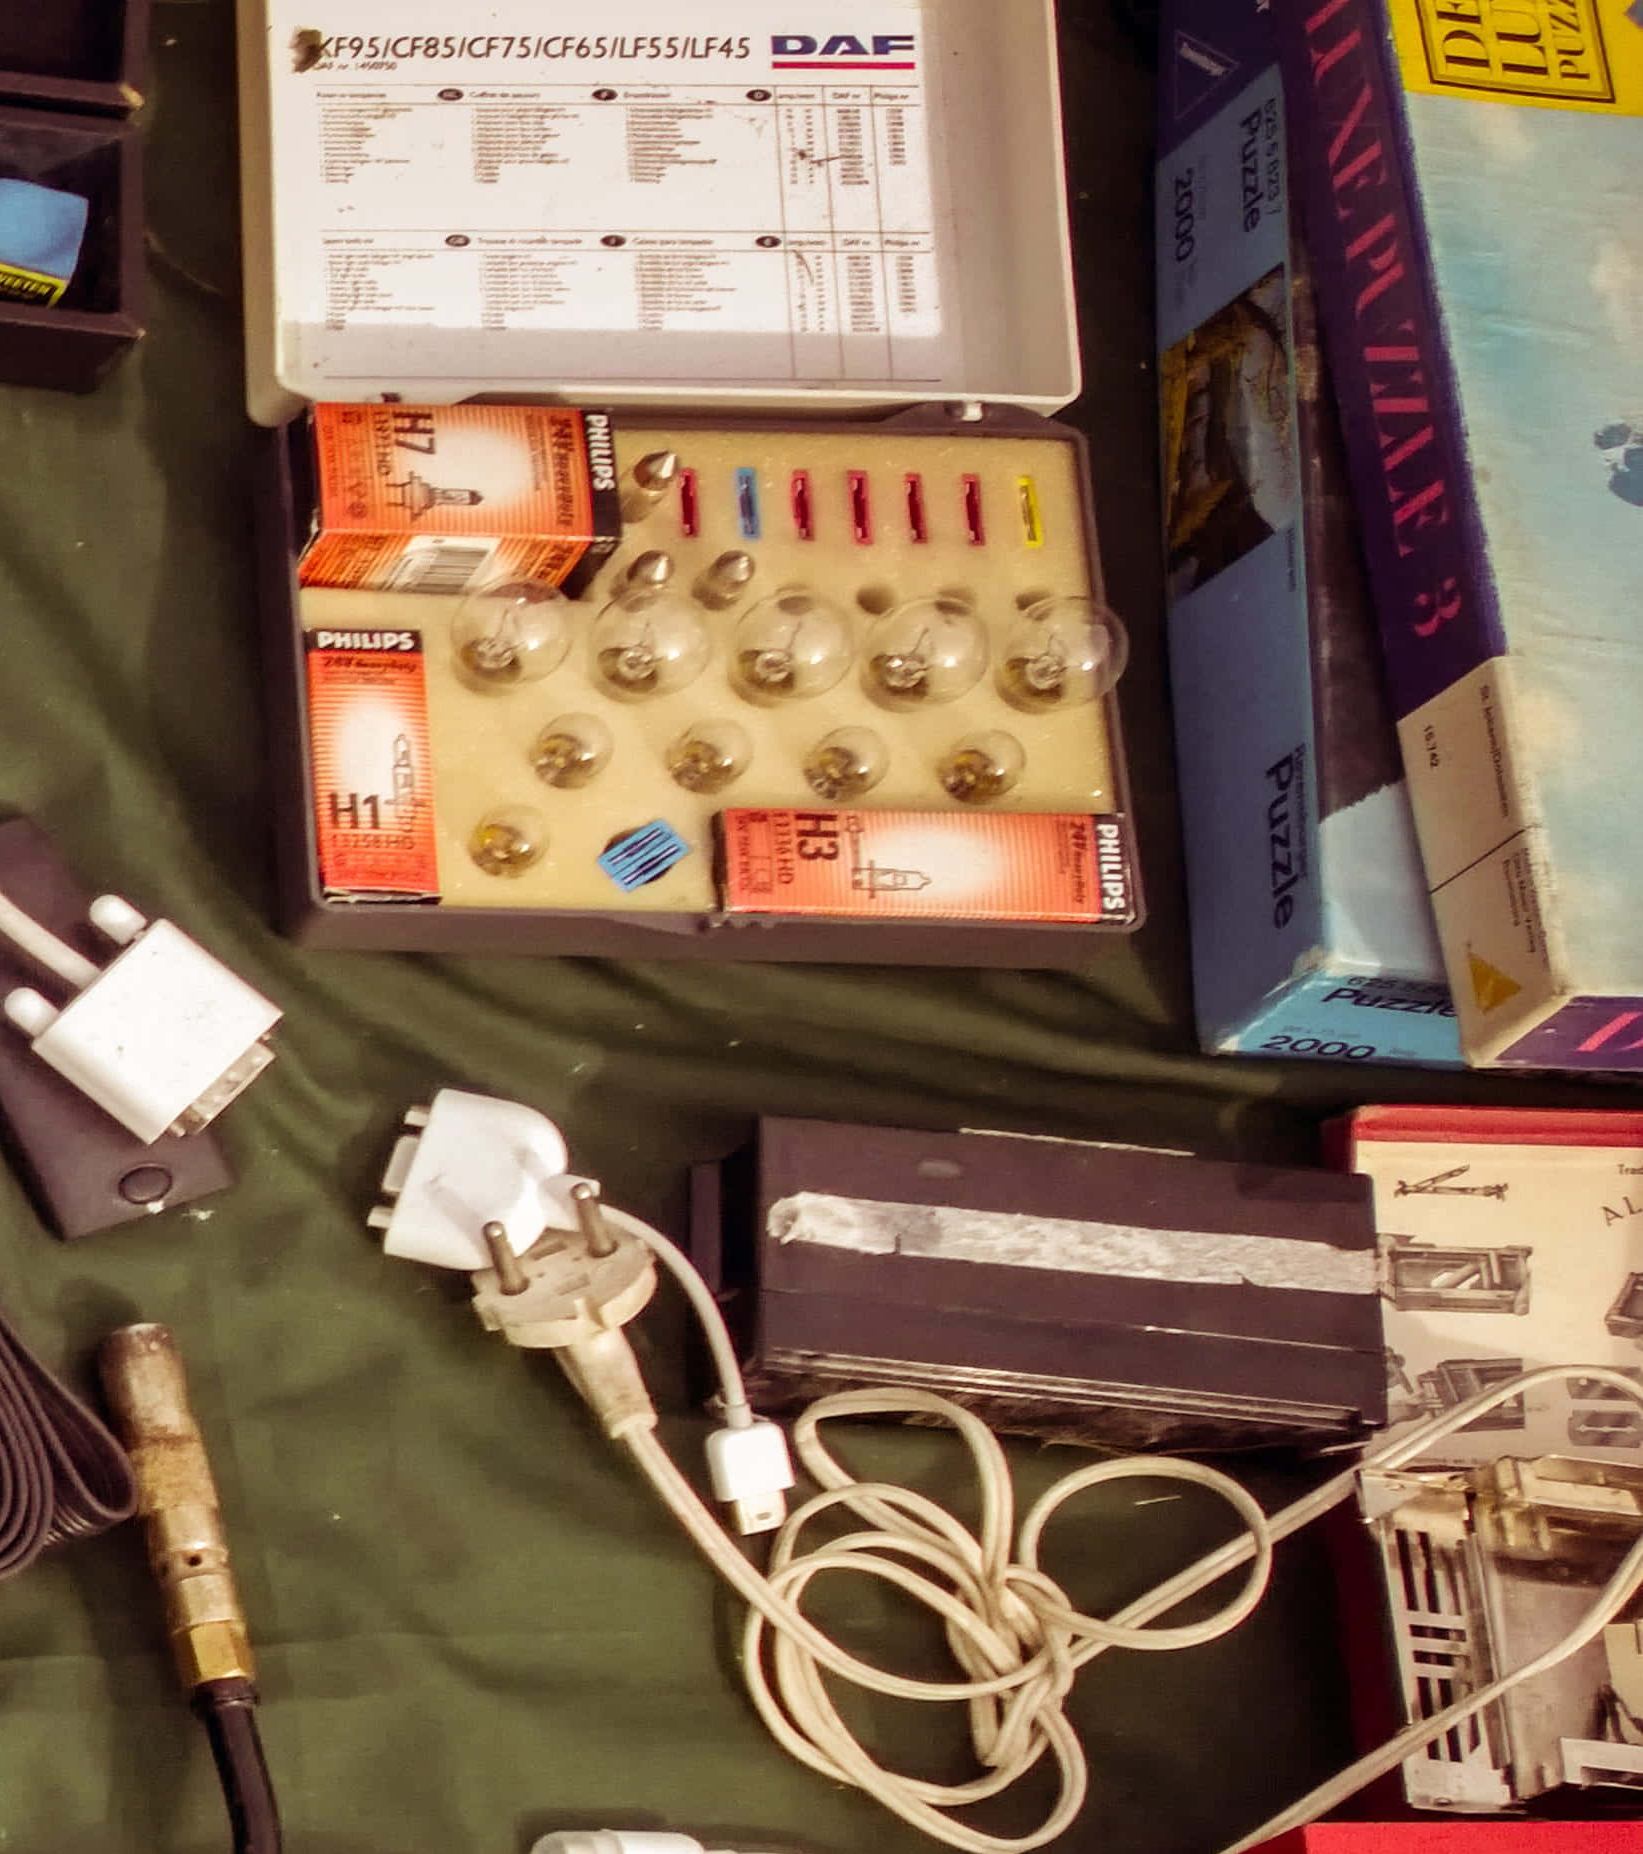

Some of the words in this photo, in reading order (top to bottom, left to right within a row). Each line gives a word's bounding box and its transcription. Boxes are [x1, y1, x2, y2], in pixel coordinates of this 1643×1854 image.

[770, 35, 915, 56] DAF
[1239, 110, 1262, 233] Puzzle
[1172, 168, 1196, 263] 2000
[394, 411, 436, 455] H7
[586, 413, 615, 491] PHILIPS
[317, 631, 415, 651] PHILIPS
[330, 792, 382, 829] H1
[796, 813, 839, 861] H3
[1264, 755, 1294, 930] Puzzle
[1097, 824, 1126, 909] PHILIPS
[1260, 1034, 1377, 1060] 2000
